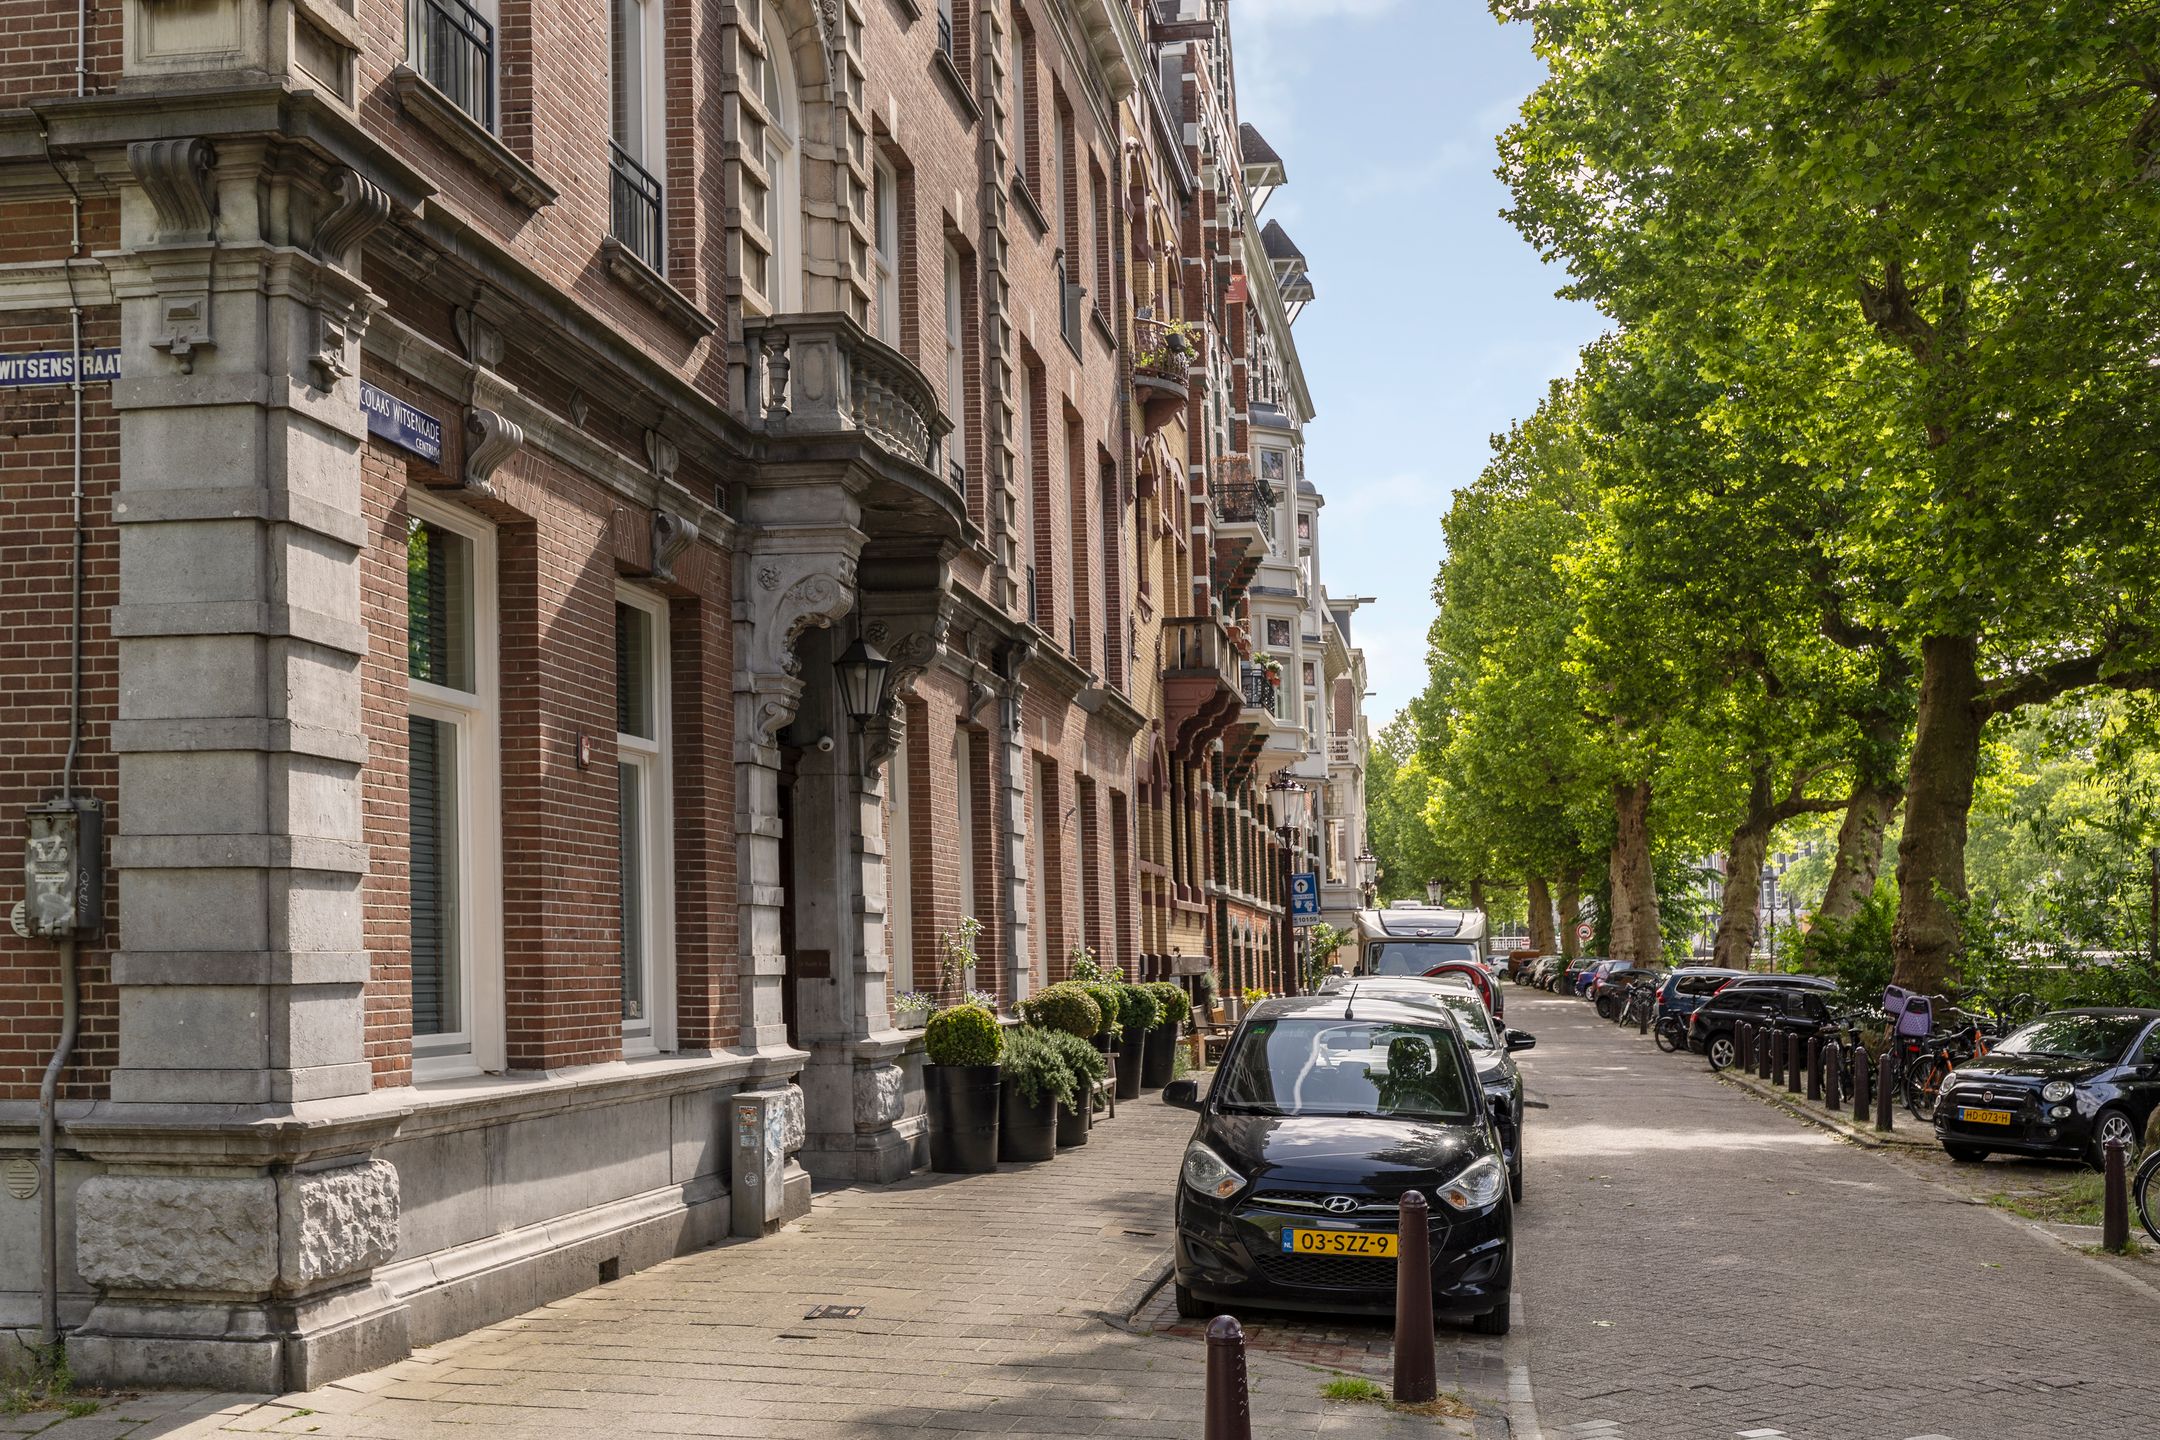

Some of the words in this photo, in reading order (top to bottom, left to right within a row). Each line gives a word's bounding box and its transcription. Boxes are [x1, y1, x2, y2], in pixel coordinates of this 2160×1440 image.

[393, 403, 440, 443] WITSENKADE
[1966, 1111, 2008, 1123] HD-073-H
[1301, 1233, 1389, 1253] 03-SZZ-9
